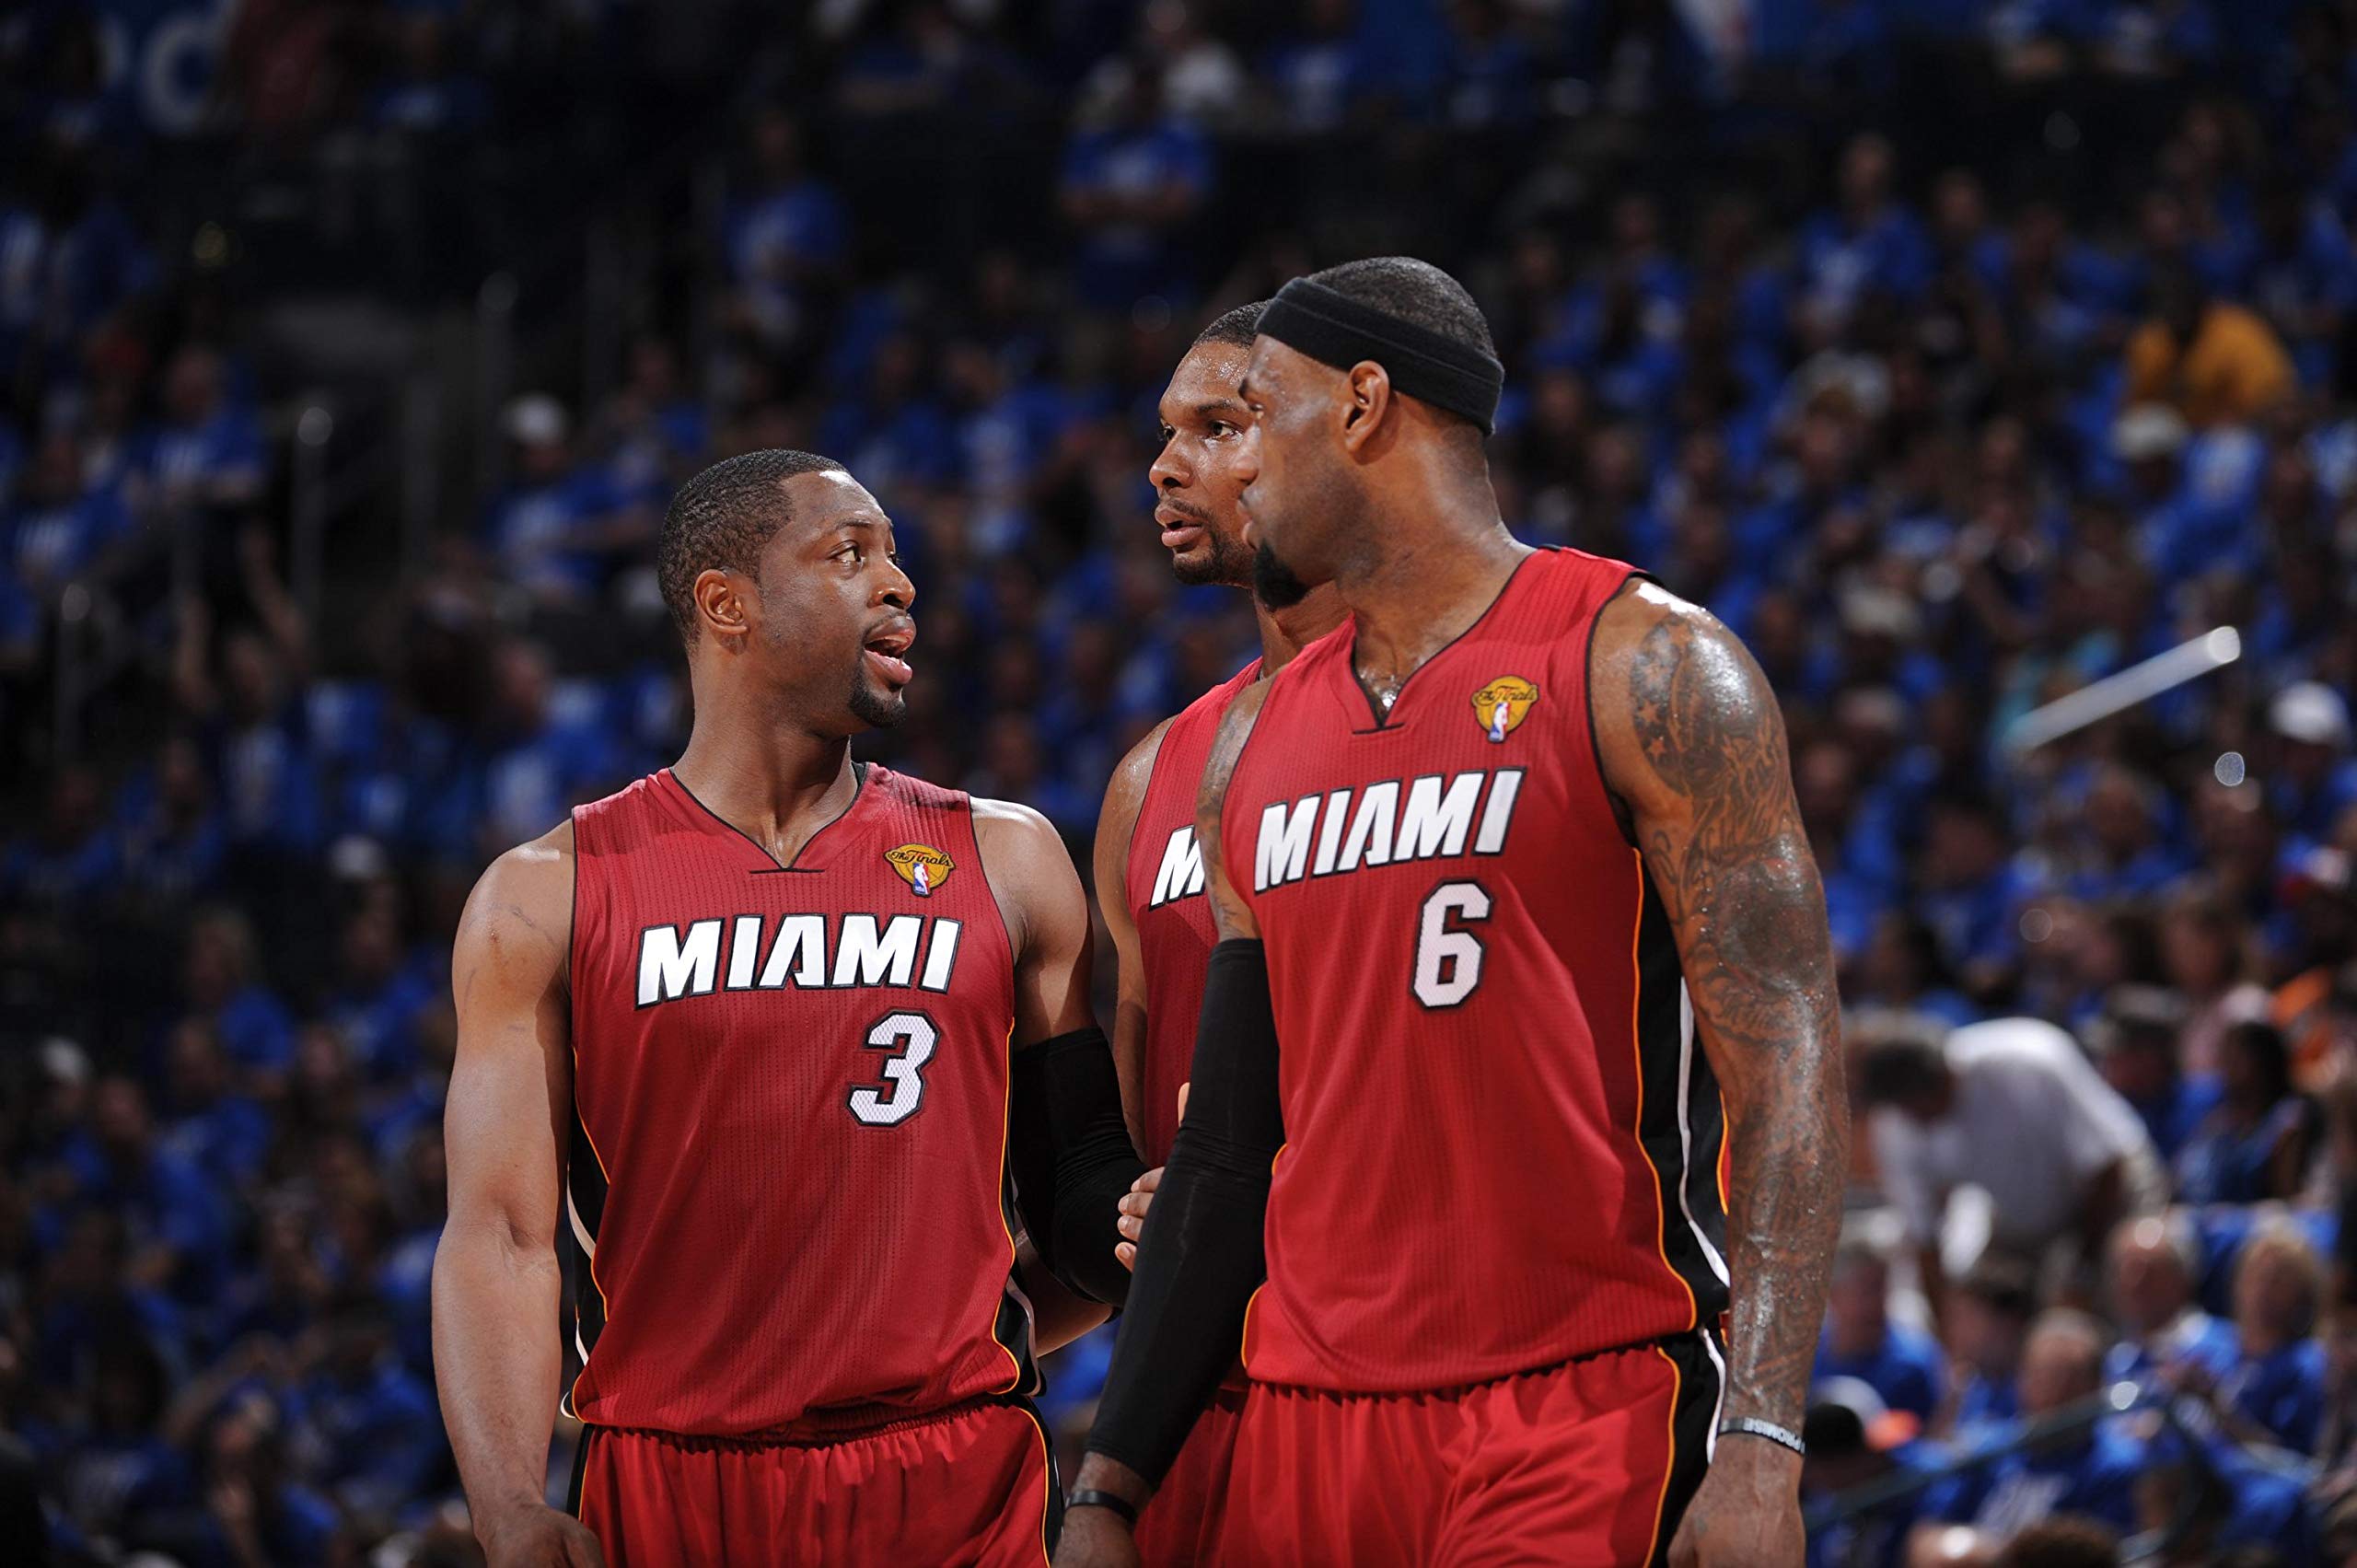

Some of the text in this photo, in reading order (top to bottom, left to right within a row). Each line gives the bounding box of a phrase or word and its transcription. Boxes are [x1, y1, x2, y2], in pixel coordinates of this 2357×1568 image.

[905, 849, 951, 867] Finals
[1255, 767, 1526, 894] MIAMI
[636, 913, 962, 1009] MIAMI
[1411, 878, 1493, 1009] 6
[847, 1009, 940, 1127] 3
